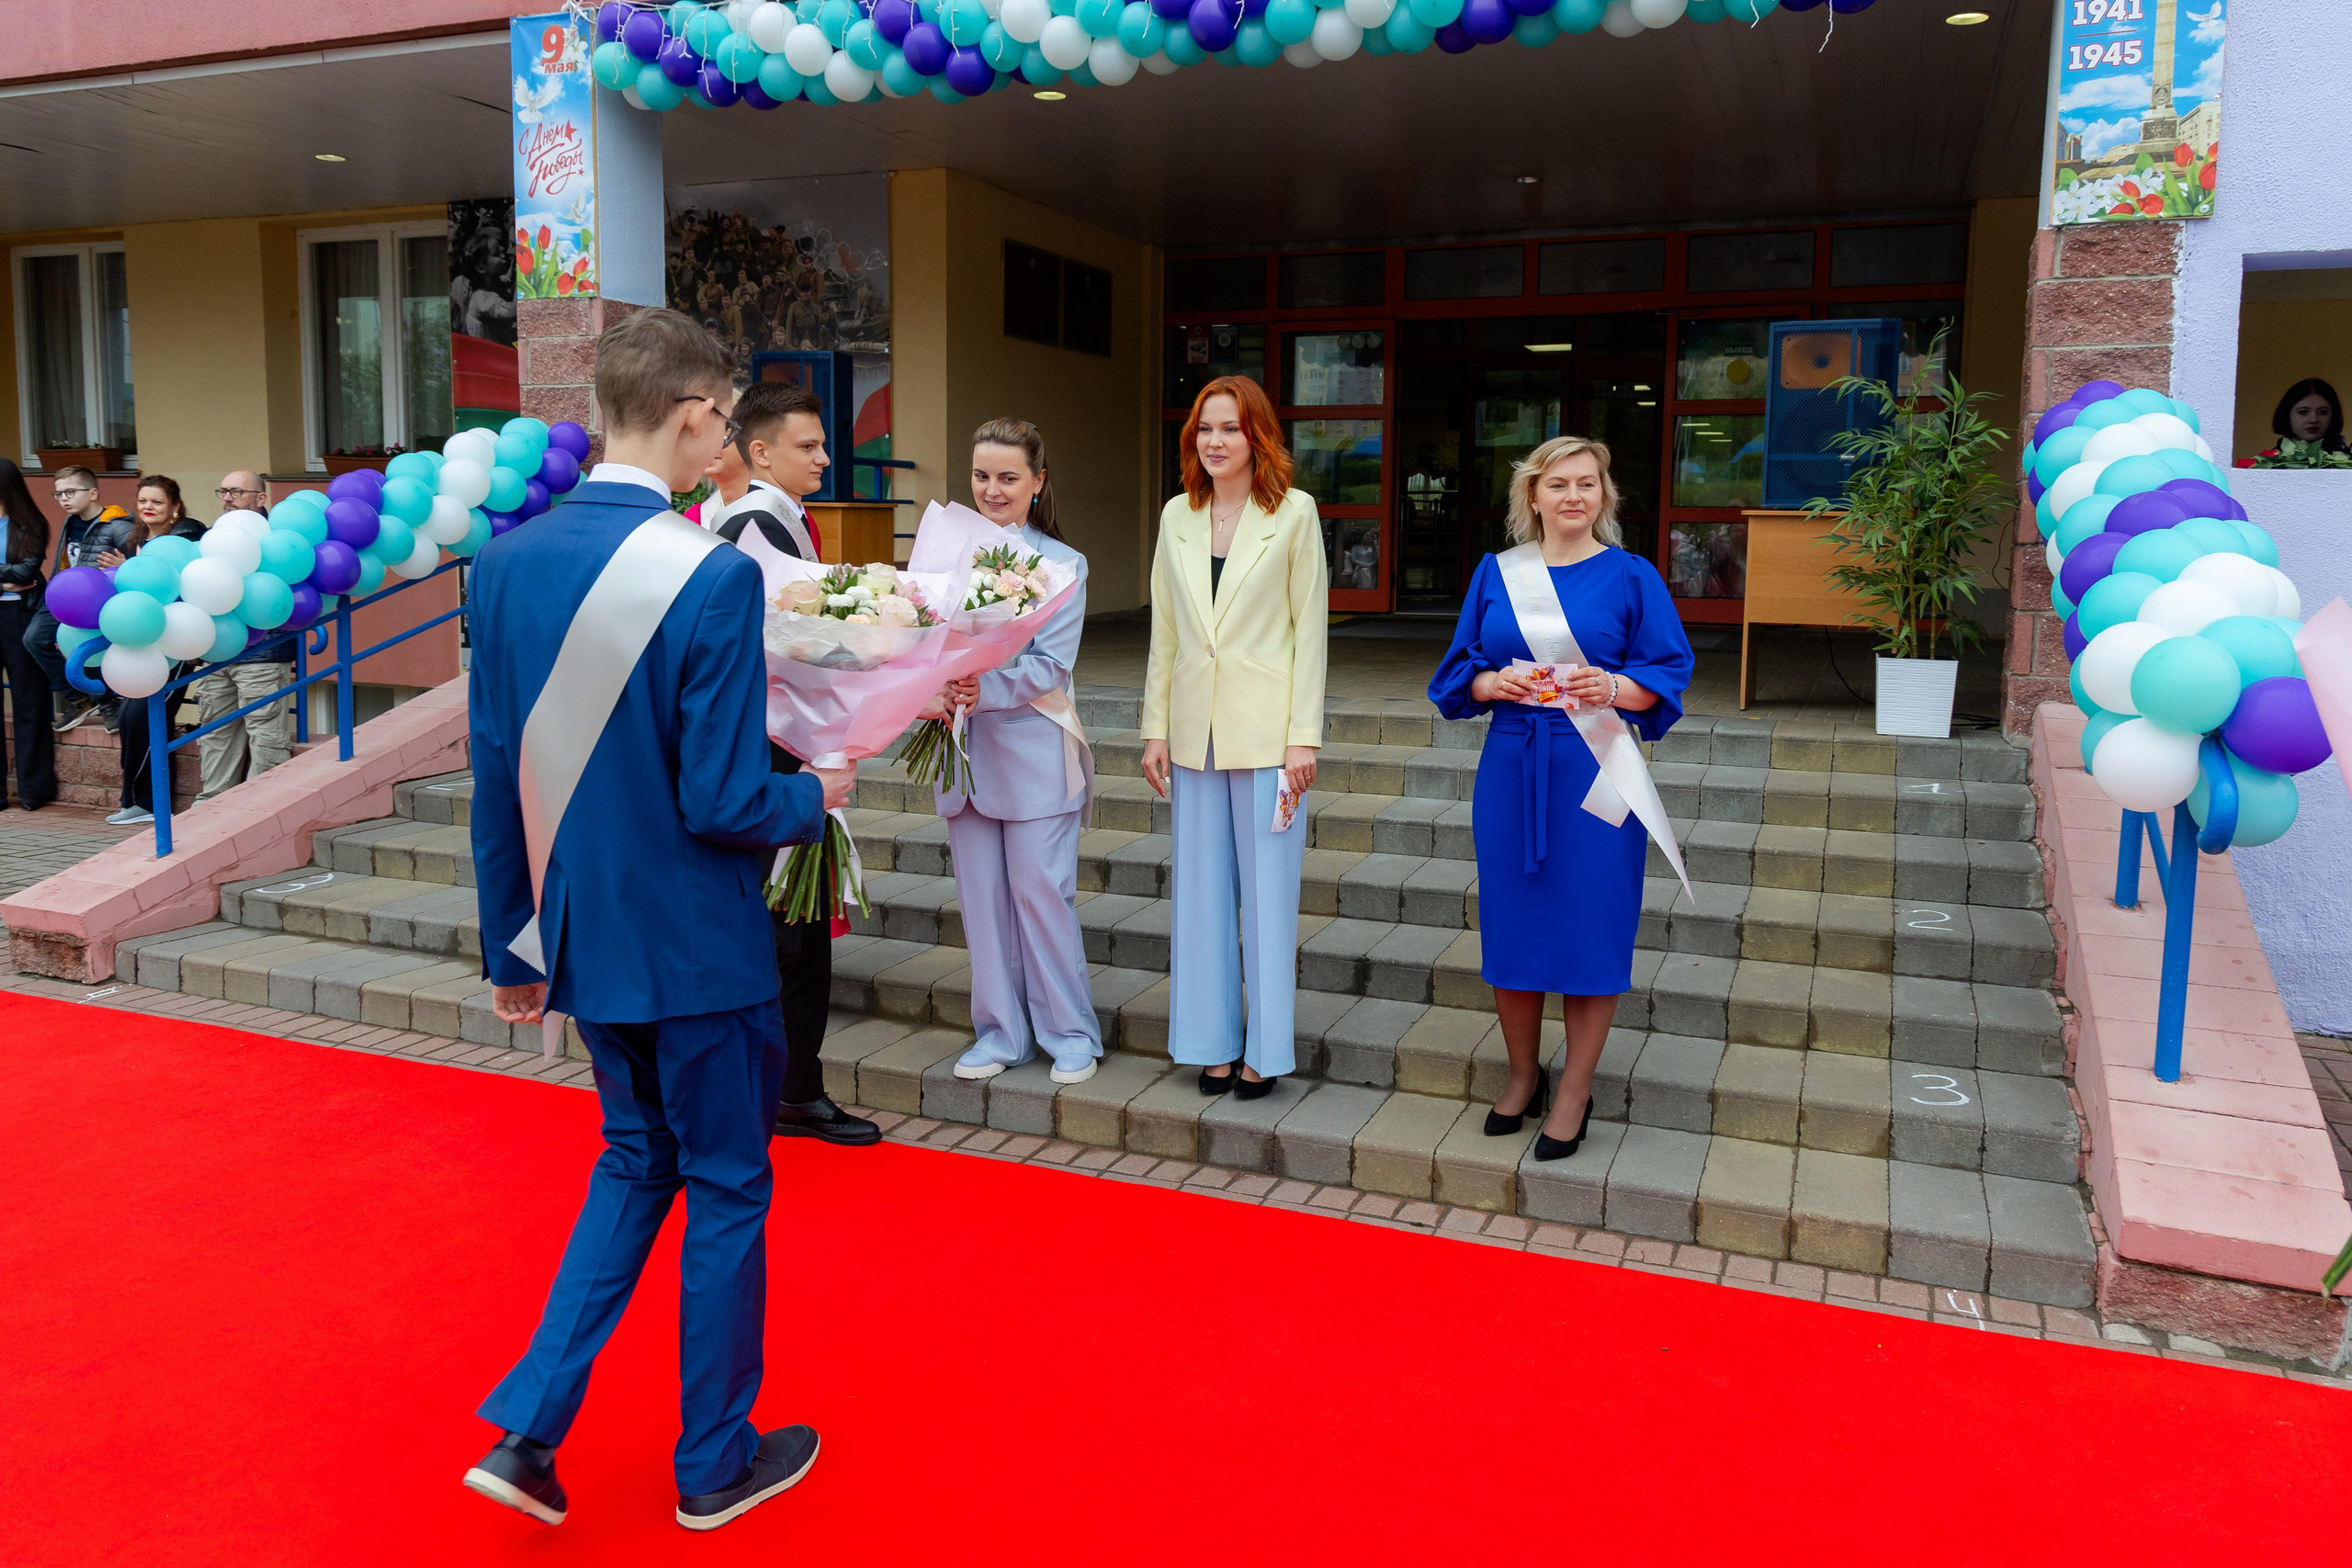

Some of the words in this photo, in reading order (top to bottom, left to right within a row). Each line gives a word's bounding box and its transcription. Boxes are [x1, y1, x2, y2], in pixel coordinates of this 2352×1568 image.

[2072, 0, 2144, 26] 1941
[541, 24, 565, 67] 9
[2068, 39, 2143, 71] 1945
[544, 62, 574, 73] мая
[518, 129, 529, 155] С
[528, 137, 583, 198] Победы
[1907, 909, 1954, 931] 2
[1910, 1074, 1971, 1106] 3
